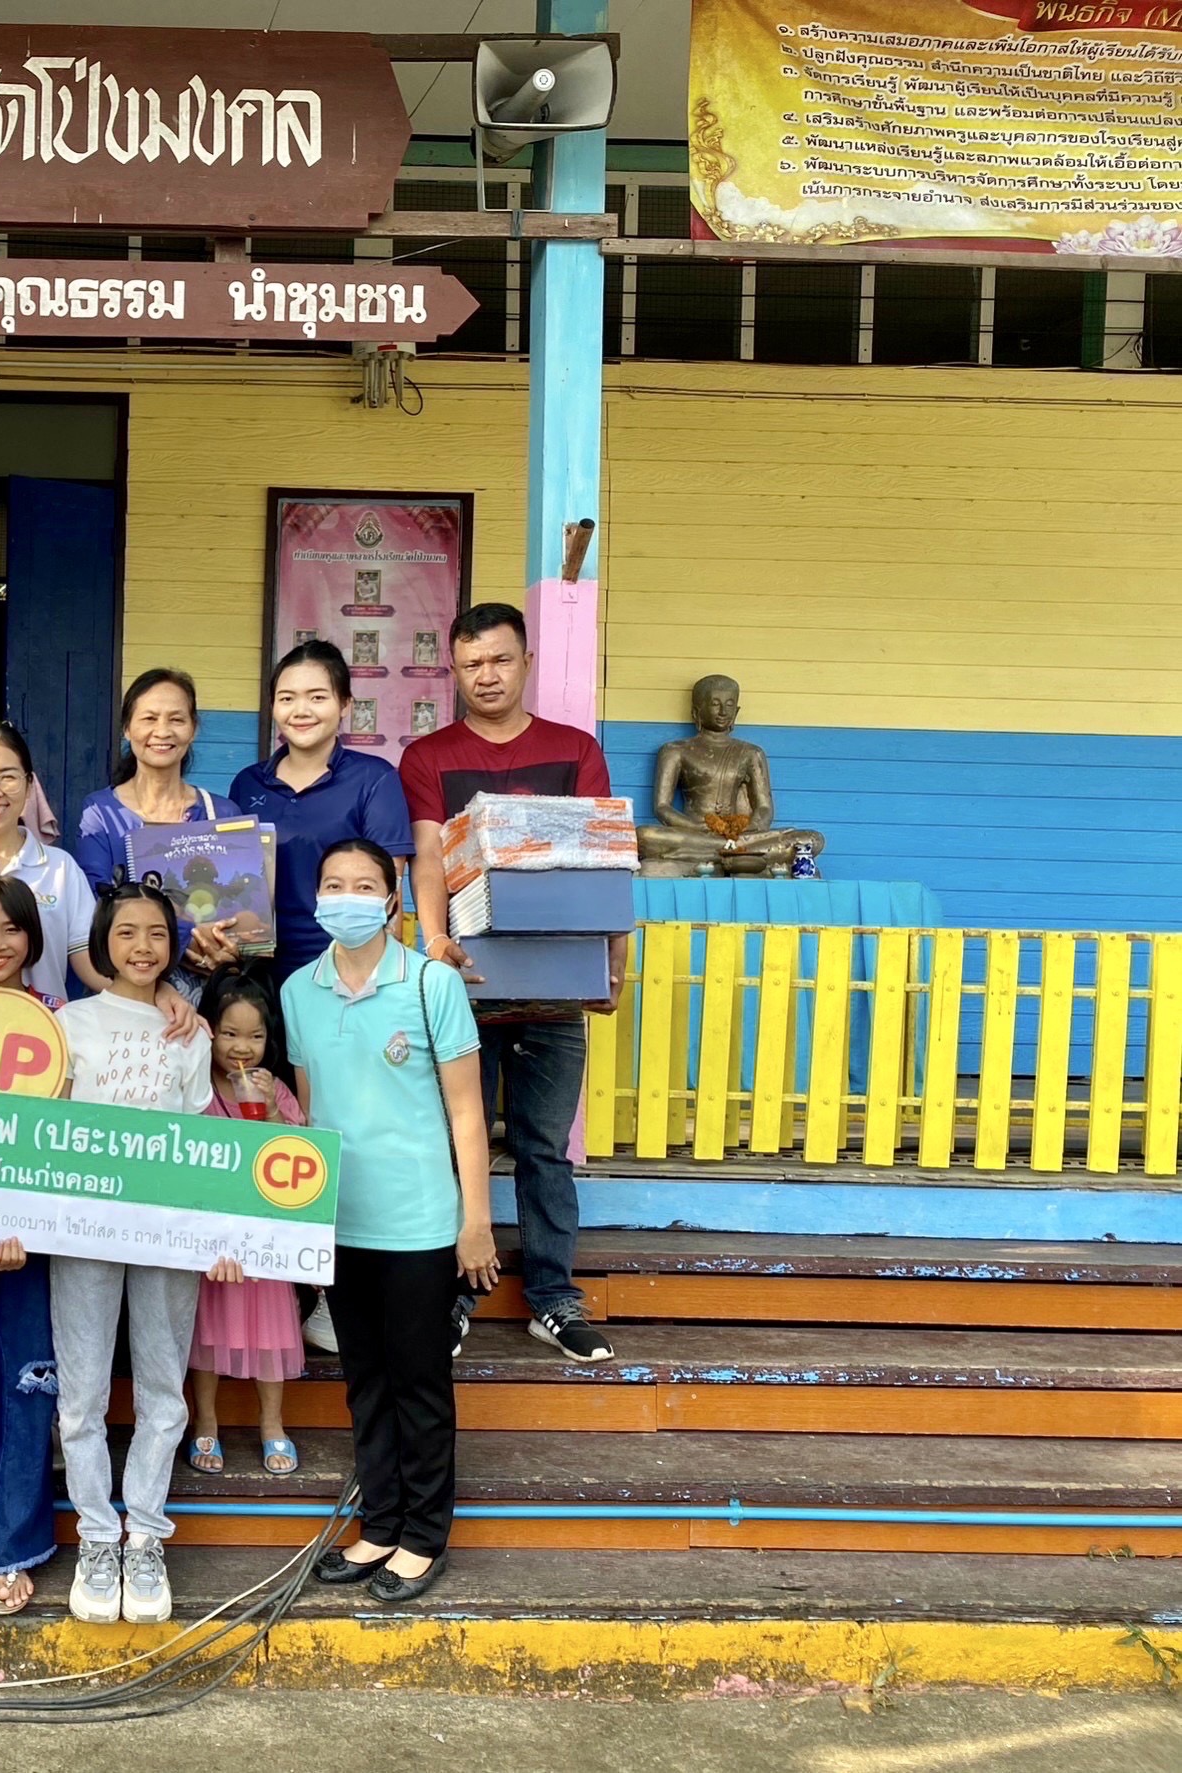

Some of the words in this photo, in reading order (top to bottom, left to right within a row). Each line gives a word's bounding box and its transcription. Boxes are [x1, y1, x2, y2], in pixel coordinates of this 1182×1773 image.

[1036, 0, 1133, 25] พนธกิจ
[803, 47, 924, 69] ปลูกฝังคุณธรรม
[803, 67, 898, 93] จัดการเรียนรู้
[804, 89, 946, 117] การศึกษาขั้นพื้นฐาน
[802, 180, 973, 205] เน้นการกระจายอำนาจ
[228, 267, 428, 339] นำชุมชน
[111, 1030, 168, 1050] TURN
[108, 1046, 169, 1069] YOUR
[96, 1064, 176, 1092] WORRIES
[112, 1085, 159, 1103] INTO
[33, 1117, 242, 1173] (ประเทศไทย)
[263, 1152, 317, 1190] CP
[65, 1214, 117, 1240] ไข่ไก่สด
[121, 1229, 129, 1241] 5
[134, 1230, 162, 1246] ถาด
[166, 1228, 228, 1257] ไก่ปรุงสุก
[232, 1231, 289, 1270] น้ำดื่ม
[297, 1247, 332, 1273] CP
